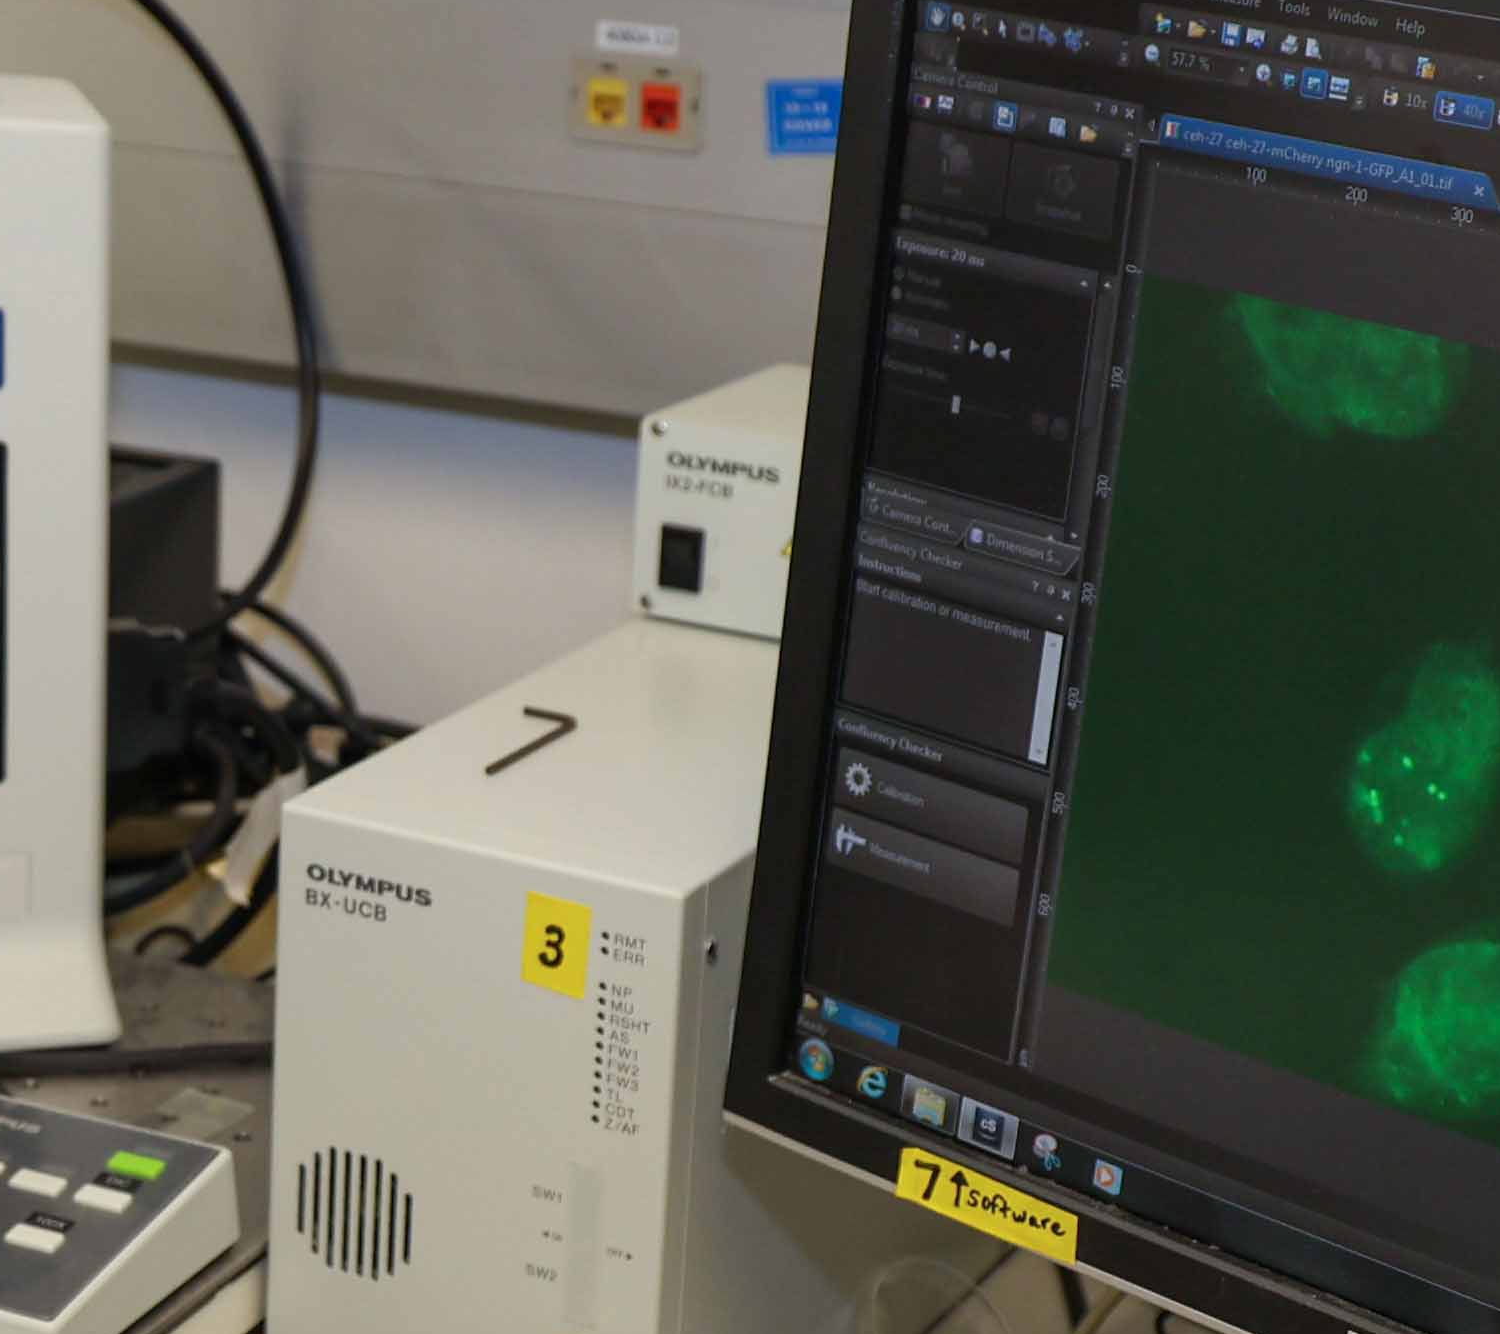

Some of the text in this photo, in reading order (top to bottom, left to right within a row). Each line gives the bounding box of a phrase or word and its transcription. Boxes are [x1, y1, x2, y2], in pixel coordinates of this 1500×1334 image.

[1327, 5, 1379, 28] Window
[1395, 17, 1426, 39] Help
[1225, 136, 1324, 169] ceh-27-mCherry
[665, 450, 781, 486] OLYMPUS
[882, 503, 923, 526] Camera
[859, 530, 963, 570] Confluency Checker
[985, 532, 1044, 561] Dimension
[857, 553, 923, 584] Instructions
[856, 577, 881, 597] Start
[881, 583, 937, 613] calibration
[951, 606, 1033, 643] measurement.
[837, 716, 944, 763] Confluency Checker
[305, 862, 434, 908] OLYMPUS
[537, 923, 567, 969] 3
[613, 931, 648, 951] RMT
[612, 947, 646, 967] ERR
[611, 983, 633, 998] NP
[610, 999, 635, 1016] MU
[609, 1028, 631, 1044] AS
[607, 1043, 640, 1061] FW1
[607, 1058, 641, 1077] FW2
[605, 1073, 641, 1093] FW3
[606, 1088, 624, 1103] TL
[603, 1102, 636, 1120] CDT
[531, 1184, 563, 1204] SW1
[914, 1158, 1066, 1238] 7 software
[525, 1262, 558, 1283] SW2
